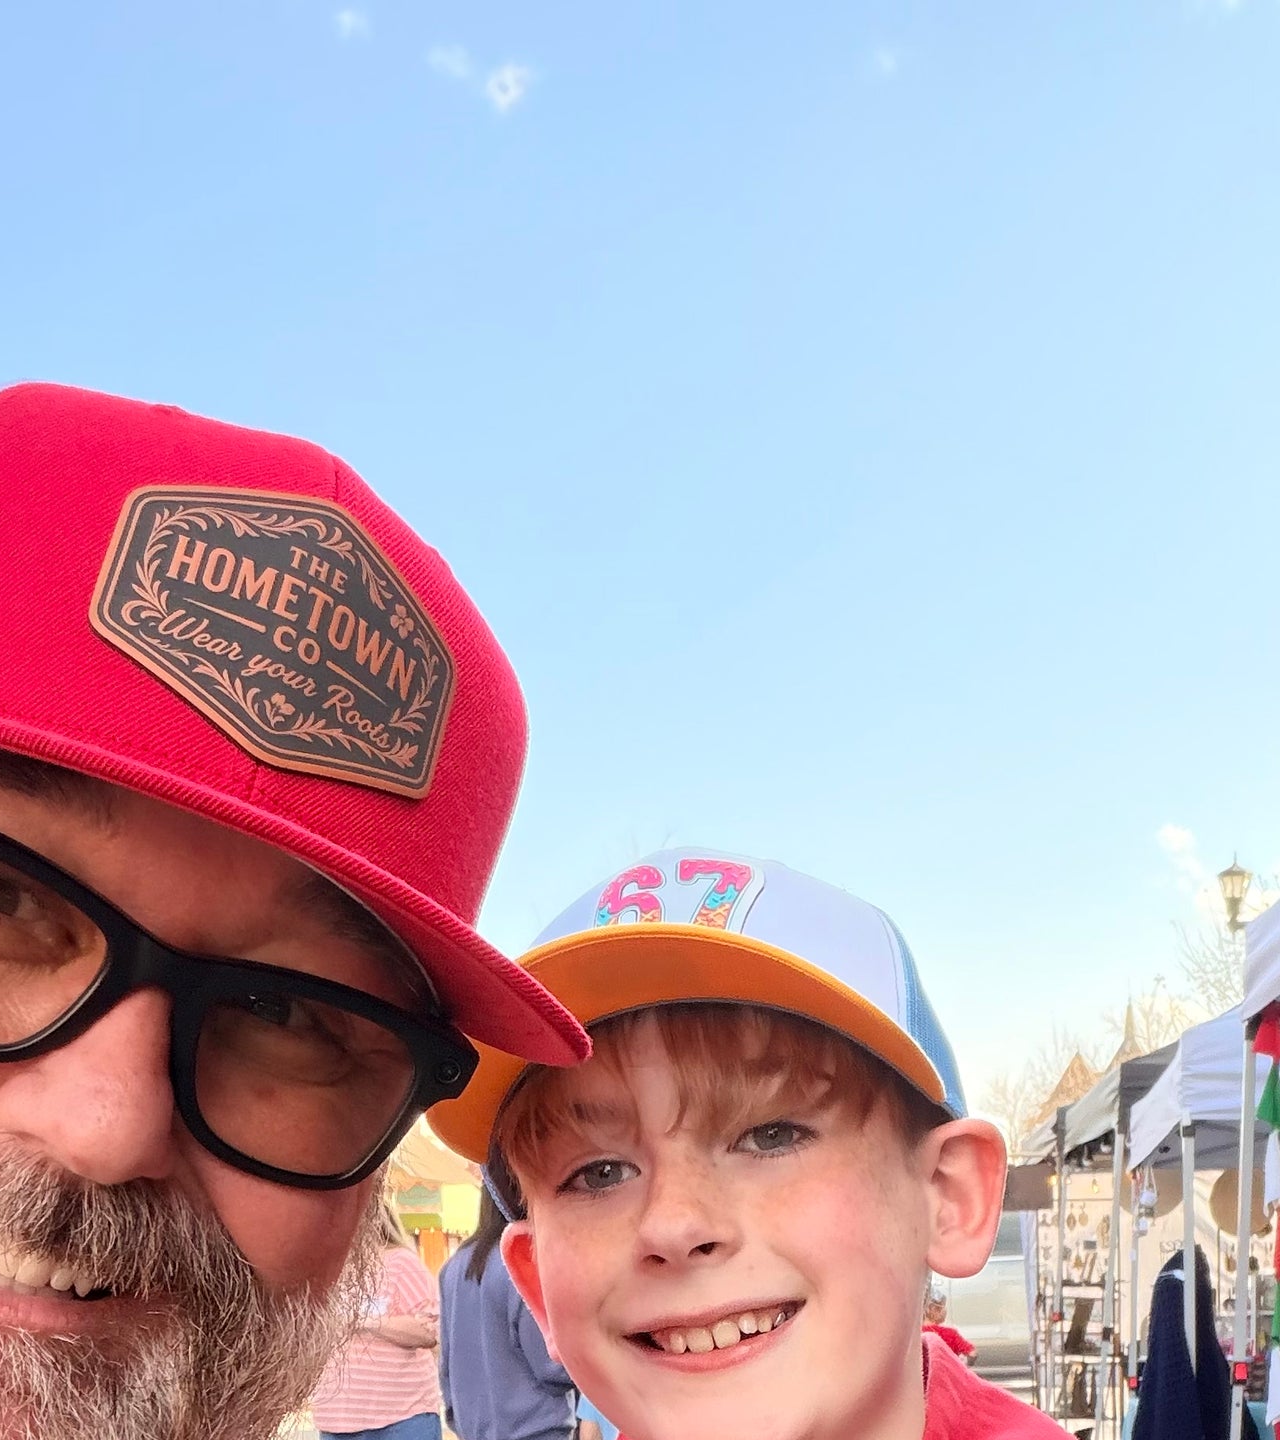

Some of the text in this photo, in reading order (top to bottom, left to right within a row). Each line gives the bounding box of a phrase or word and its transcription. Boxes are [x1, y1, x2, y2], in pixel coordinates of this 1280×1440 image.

[289, 546, 348, 595] THE
[166, 535, 417, 701] HOMETOWN
[271, 625, 321, 666] CO
[157, 610, 391, 749] Wear your Roots
[594, 858, 756, 931] 67
